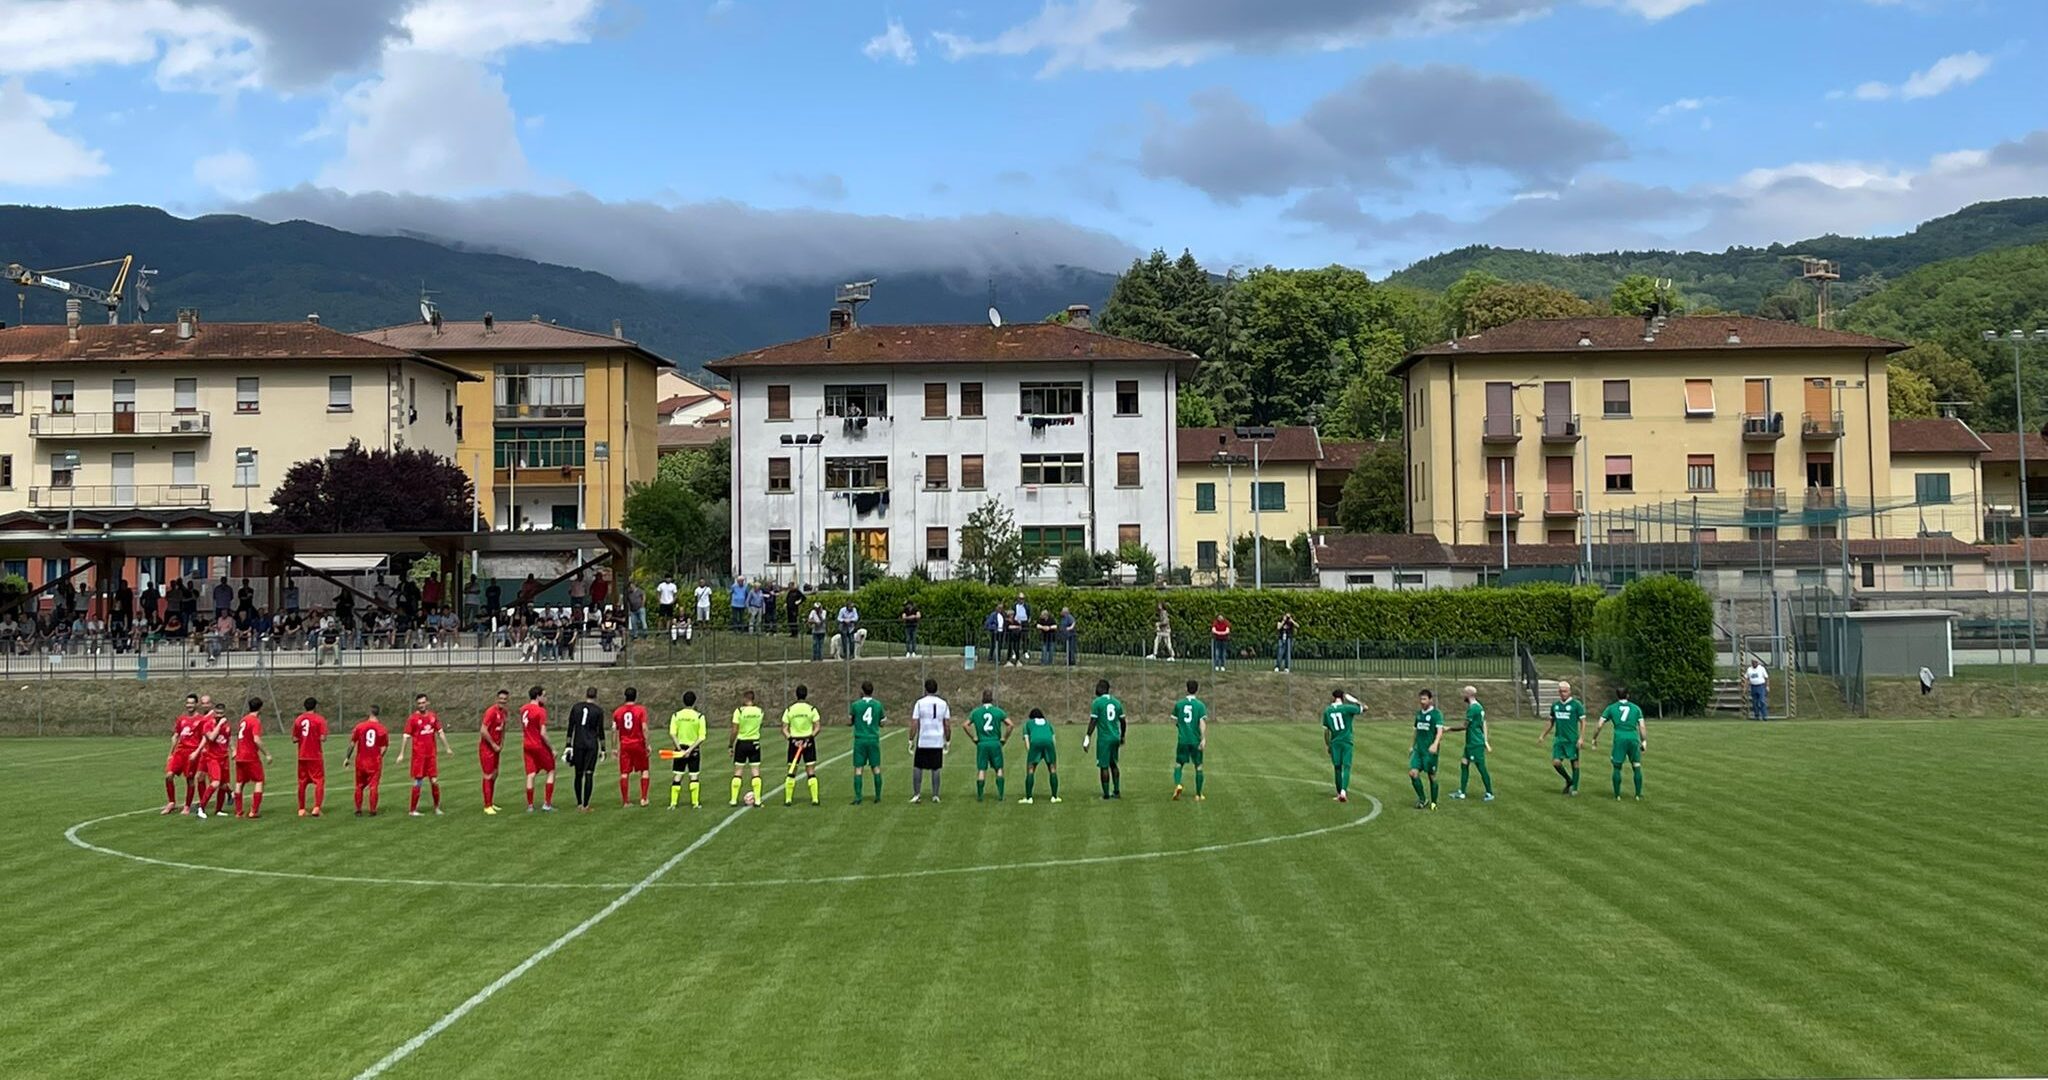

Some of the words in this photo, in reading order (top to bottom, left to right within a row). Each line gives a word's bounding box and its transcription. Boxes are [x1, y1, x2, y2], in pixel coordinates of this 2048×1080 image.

[522, 710, 529, 727] 4
[582, 707, 588, 725] 1
[624, 711, 633, 729] 8
[862, 706, 872, 725] 4
[932, 703, 937, 719] 1
[1107, 704, 1115, 721] 6
[1184, 705, 1192, 723] 5
[1620, 705, 1630, 722] 7
[238, 721, 246, 739] 2
[301, 719, 310, 737] 3
[983, 713, 993, 730] 2
[1331, 712, 1345, 731] 11
[365, 729, 375, 747] 9
